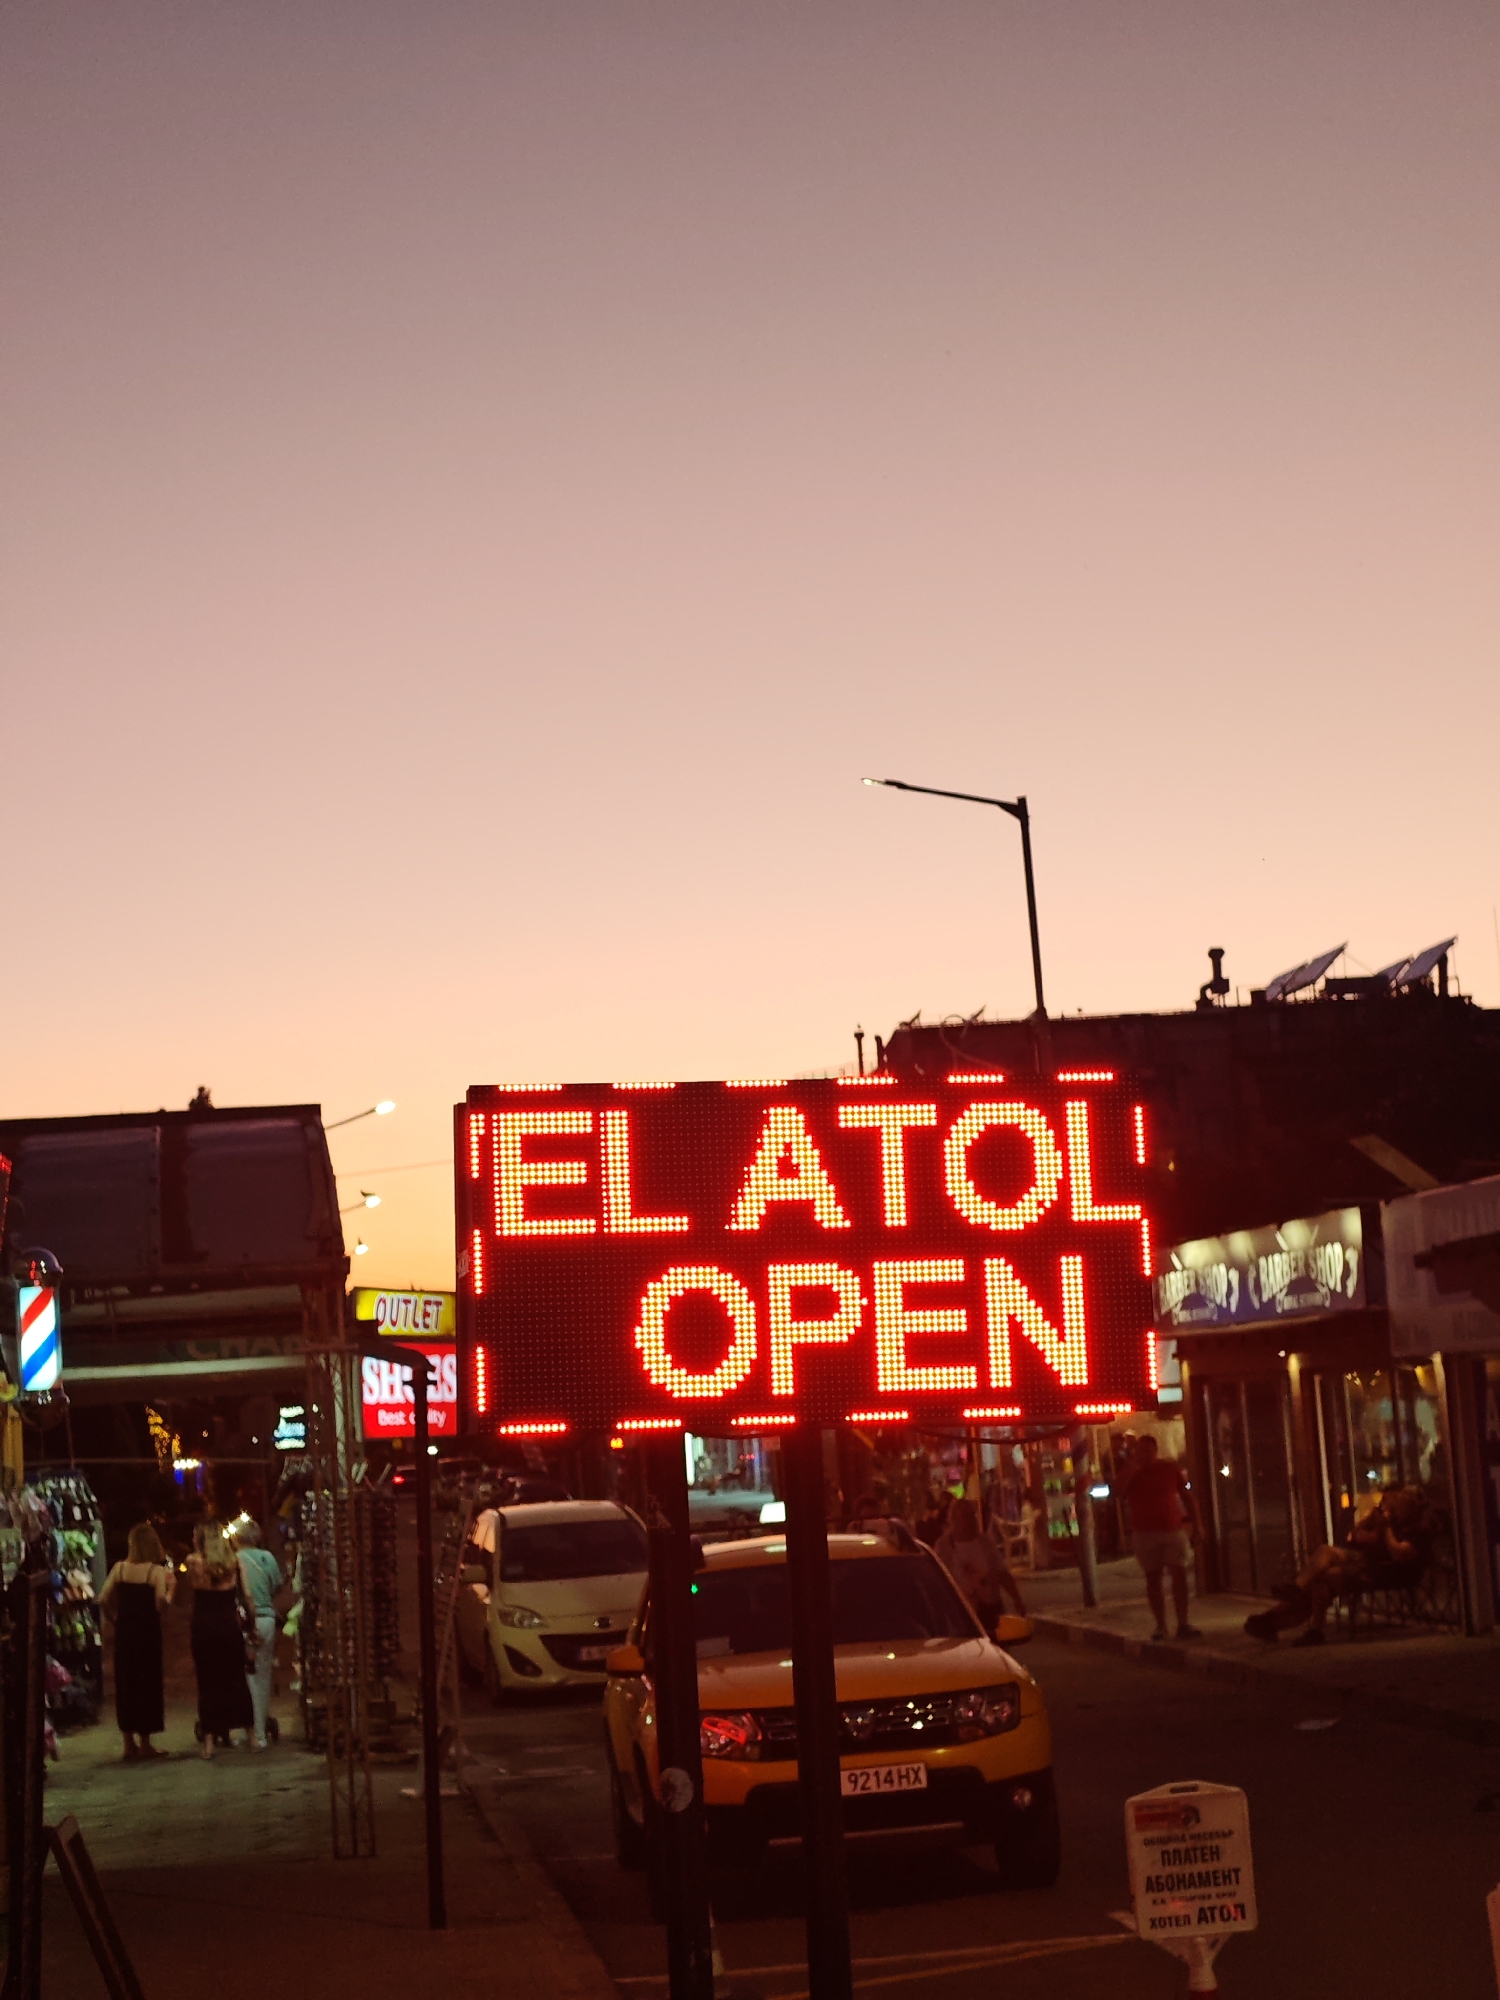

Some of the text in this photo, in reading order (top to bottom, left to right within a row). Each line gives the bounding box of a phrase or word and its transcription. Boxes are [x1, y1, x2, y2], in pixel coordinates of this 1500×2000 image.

[492, 1099, 1143, 1237] EL ATOL
[1258, 1241, 1344, 1303] BARBER SHOP
[374, 1293, 444, 1333] OUTLET
[634, 1254, 1088, 1399] OPEN
[377, 1409, 406, 1426] Best
[1160, 1844, 1220, 1867] ПЛАТЕН
[1145, 1868, 1242, 1894] АБОНАМЕНТ
[1149, 1903, 1247, 1930] ХОТЕЛ АТОЛ
